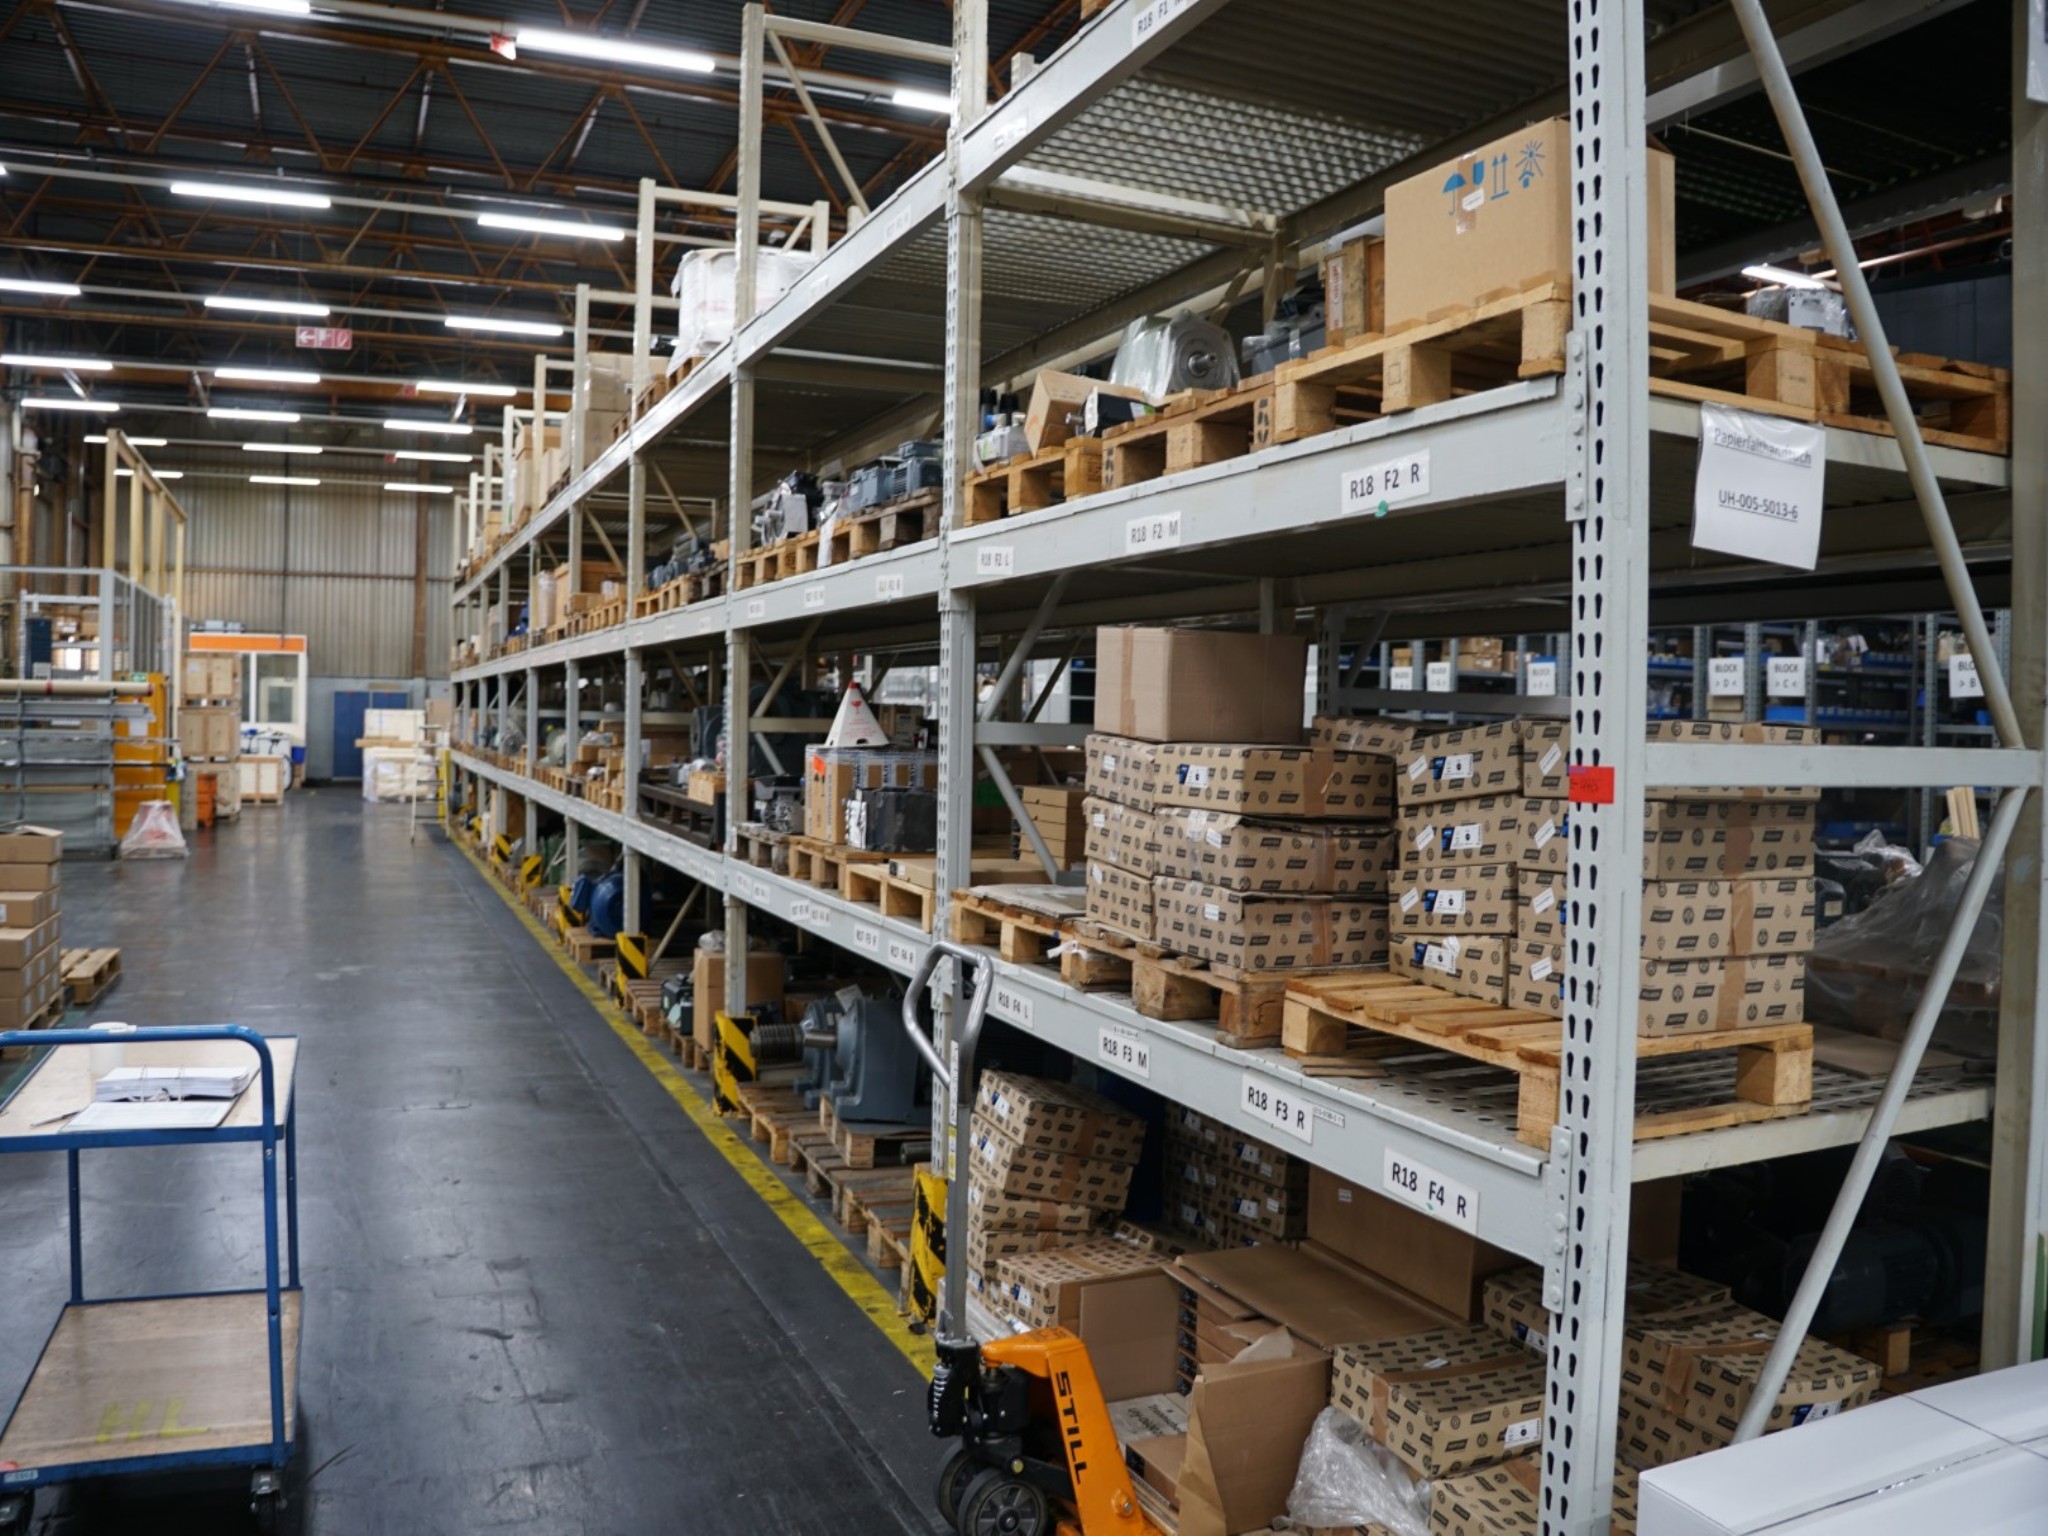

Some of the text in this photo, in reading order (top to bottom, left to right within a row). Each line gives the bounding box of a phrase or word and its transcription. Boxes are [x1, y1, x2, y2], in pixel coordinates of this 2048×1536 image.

[1350, 463, 1420, 500] R18 F2 R
[1718, 488, 1799, 520] UH-005-5013-6
[1131, 519, 1178, 543] R18 F2 M
[1714, 664, 1738, 674] BLOCK
[1774, 663, 1799, 674] BLOCK
[1958, 661, 1975, 672] BLO
[998, 991, 1010, 1009] R18
[1024, 1003, 1028, 1019] L
[1102, 1037, 1147, 1068] R18 F3 M
[1248, 1086, 1268, 1112] R18
[1275, 1099, 1288, 1121] F3
[1297, 1110, 1305, 1130] R
[1392, 1162, 1467, 1219] R18 F4 R
[1055, 1371, 1087, 1485] STILL
